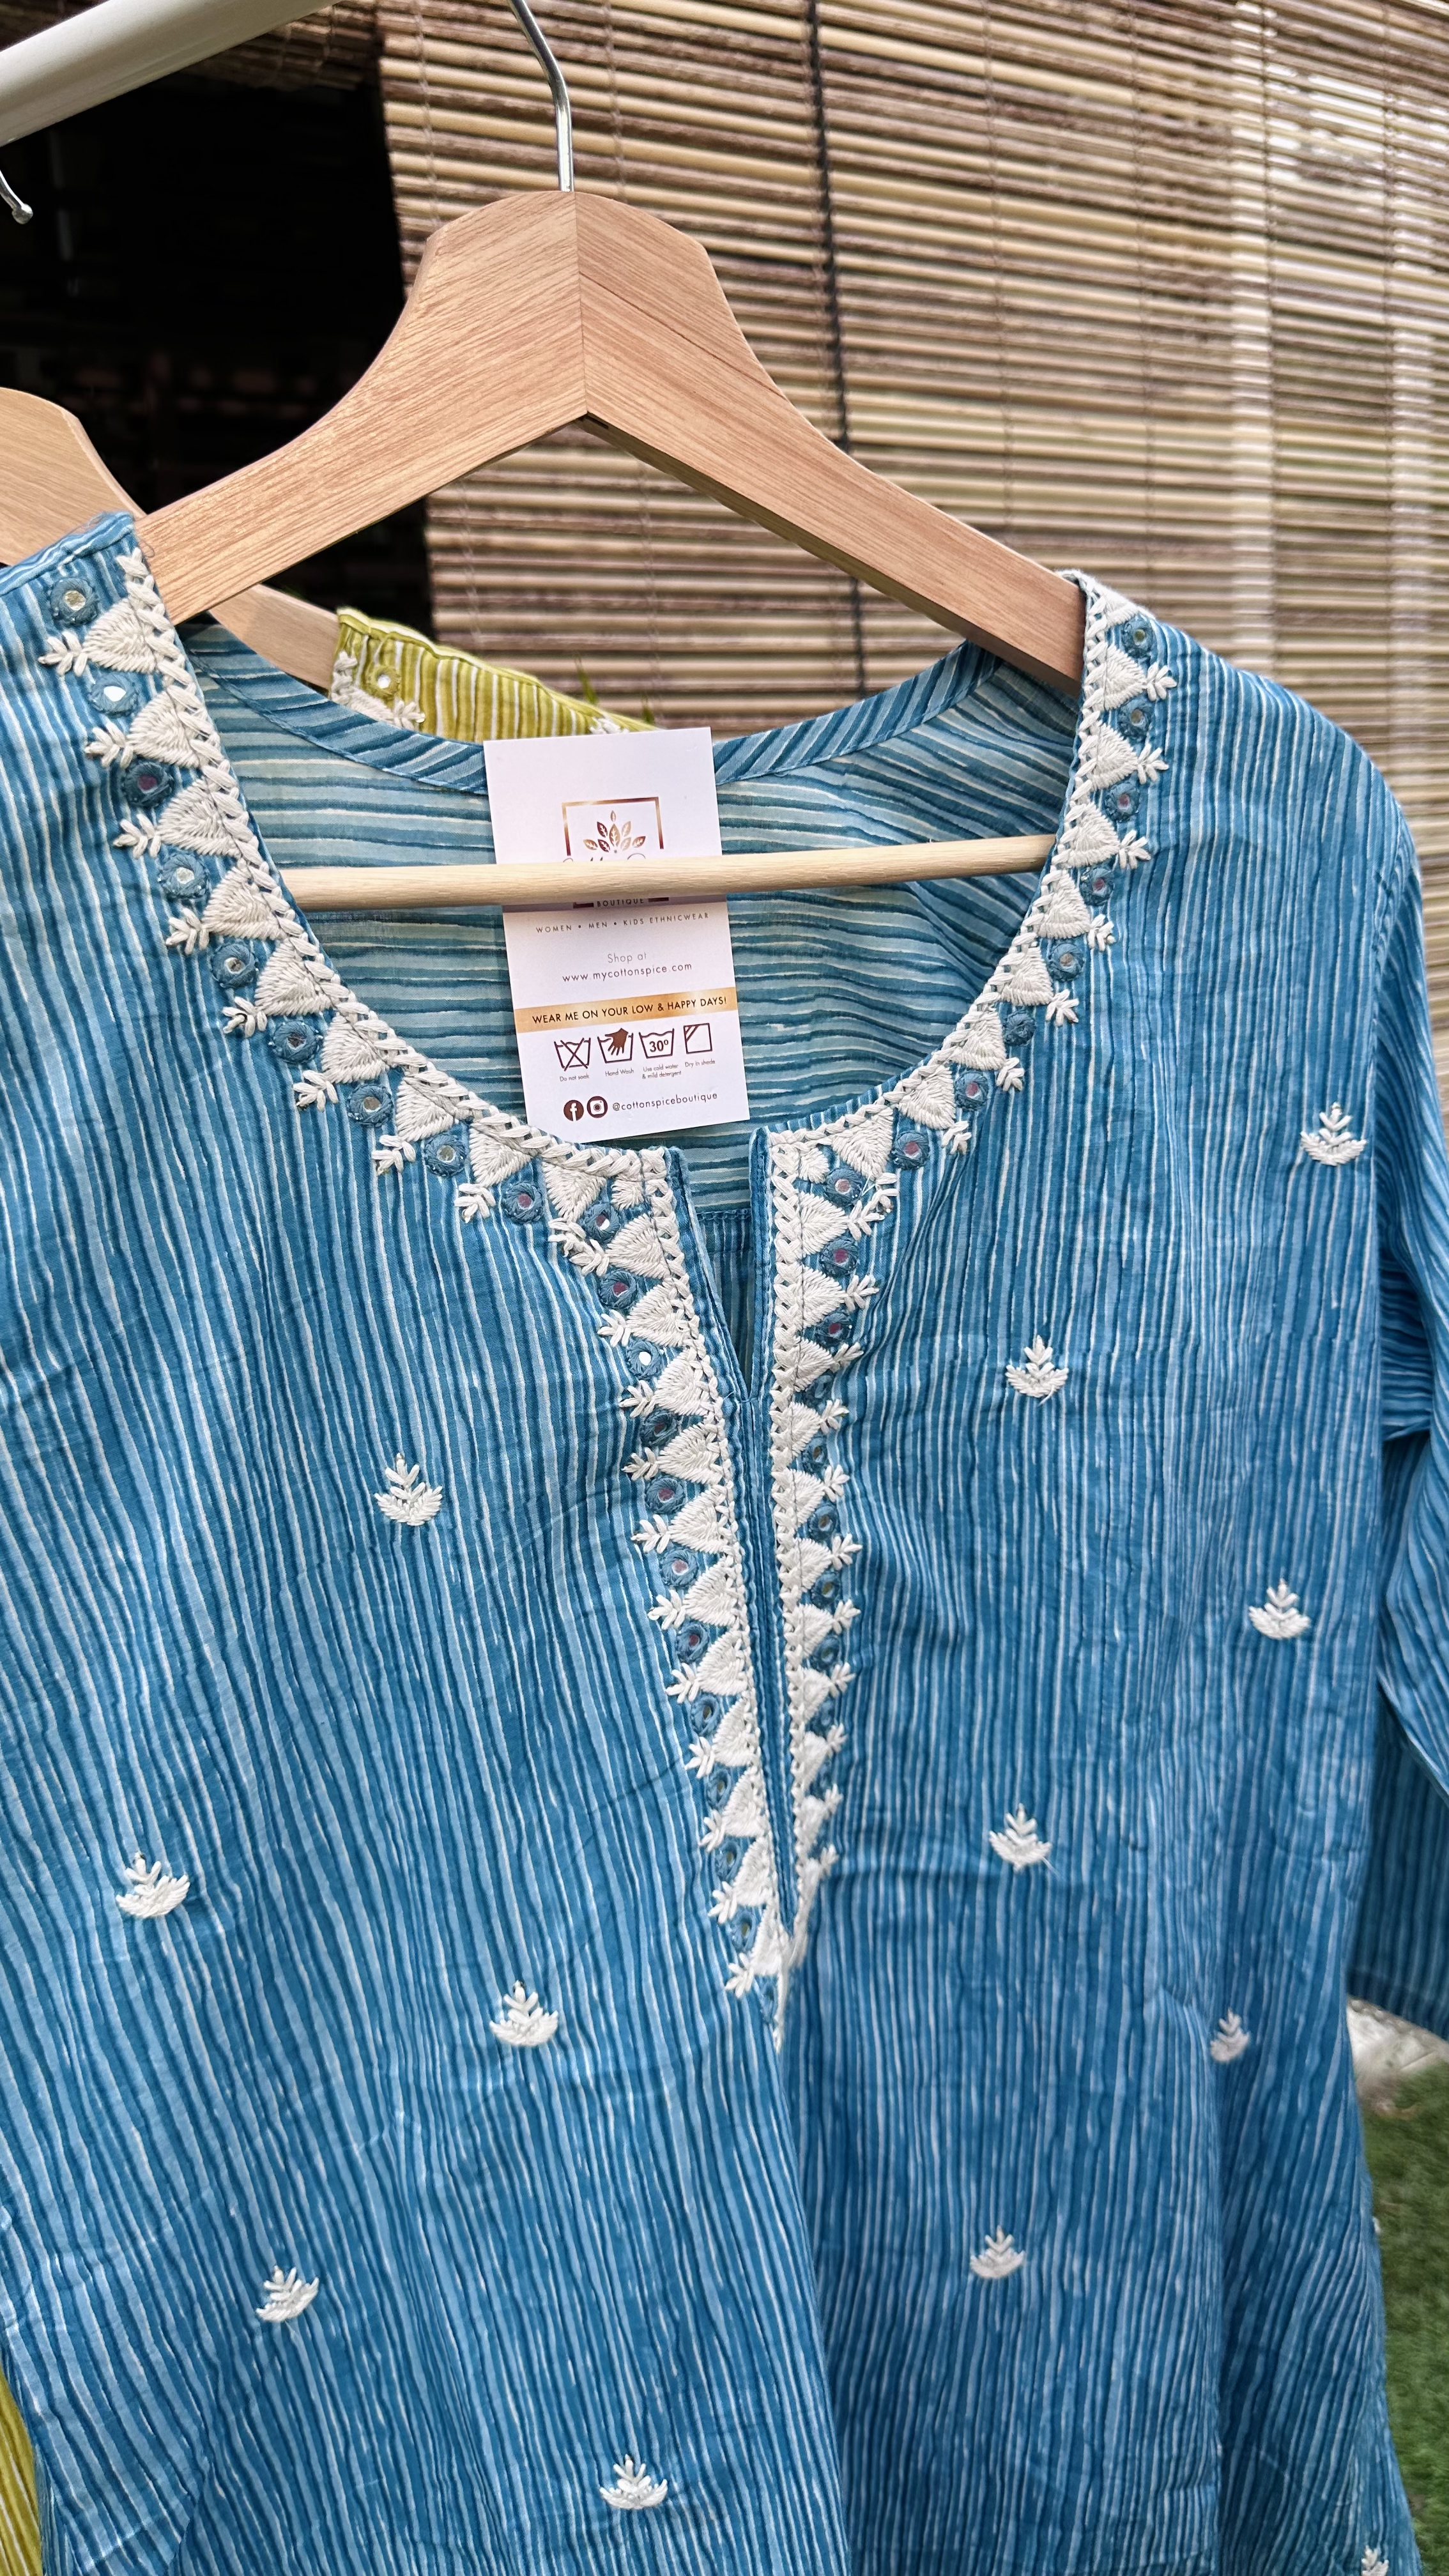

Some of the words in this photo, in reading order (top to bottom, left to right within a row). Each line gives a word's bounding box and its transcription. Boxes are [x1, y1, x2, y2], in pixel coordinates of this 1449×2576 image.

[597, 898, 645, 907] BOUTIQUE
[535, 924, 572, 933] WOMEN
[649, 912, 709, 924] ETHNICWEAR
[608, 953, 632, 963] Shop
[637, 952, 647, 960] at
[532, 1013, 561, 1024] WEAR
[565, 1011, 579, 1021] ME
[583, 1009, 598, 1019] ON
[601, 1007, 628, 1017] YOUR
[632, 1004, 654, 1014] LOW
[657, 1003, 664, 1011] &
[668, 999, 696, 1011] HAPPY
[700, 996, 726, 1007] DAYS!
[605, 1068, 618, 1077] Hand
[612, 1092, 717, 1112] @cottonspiceboutique
